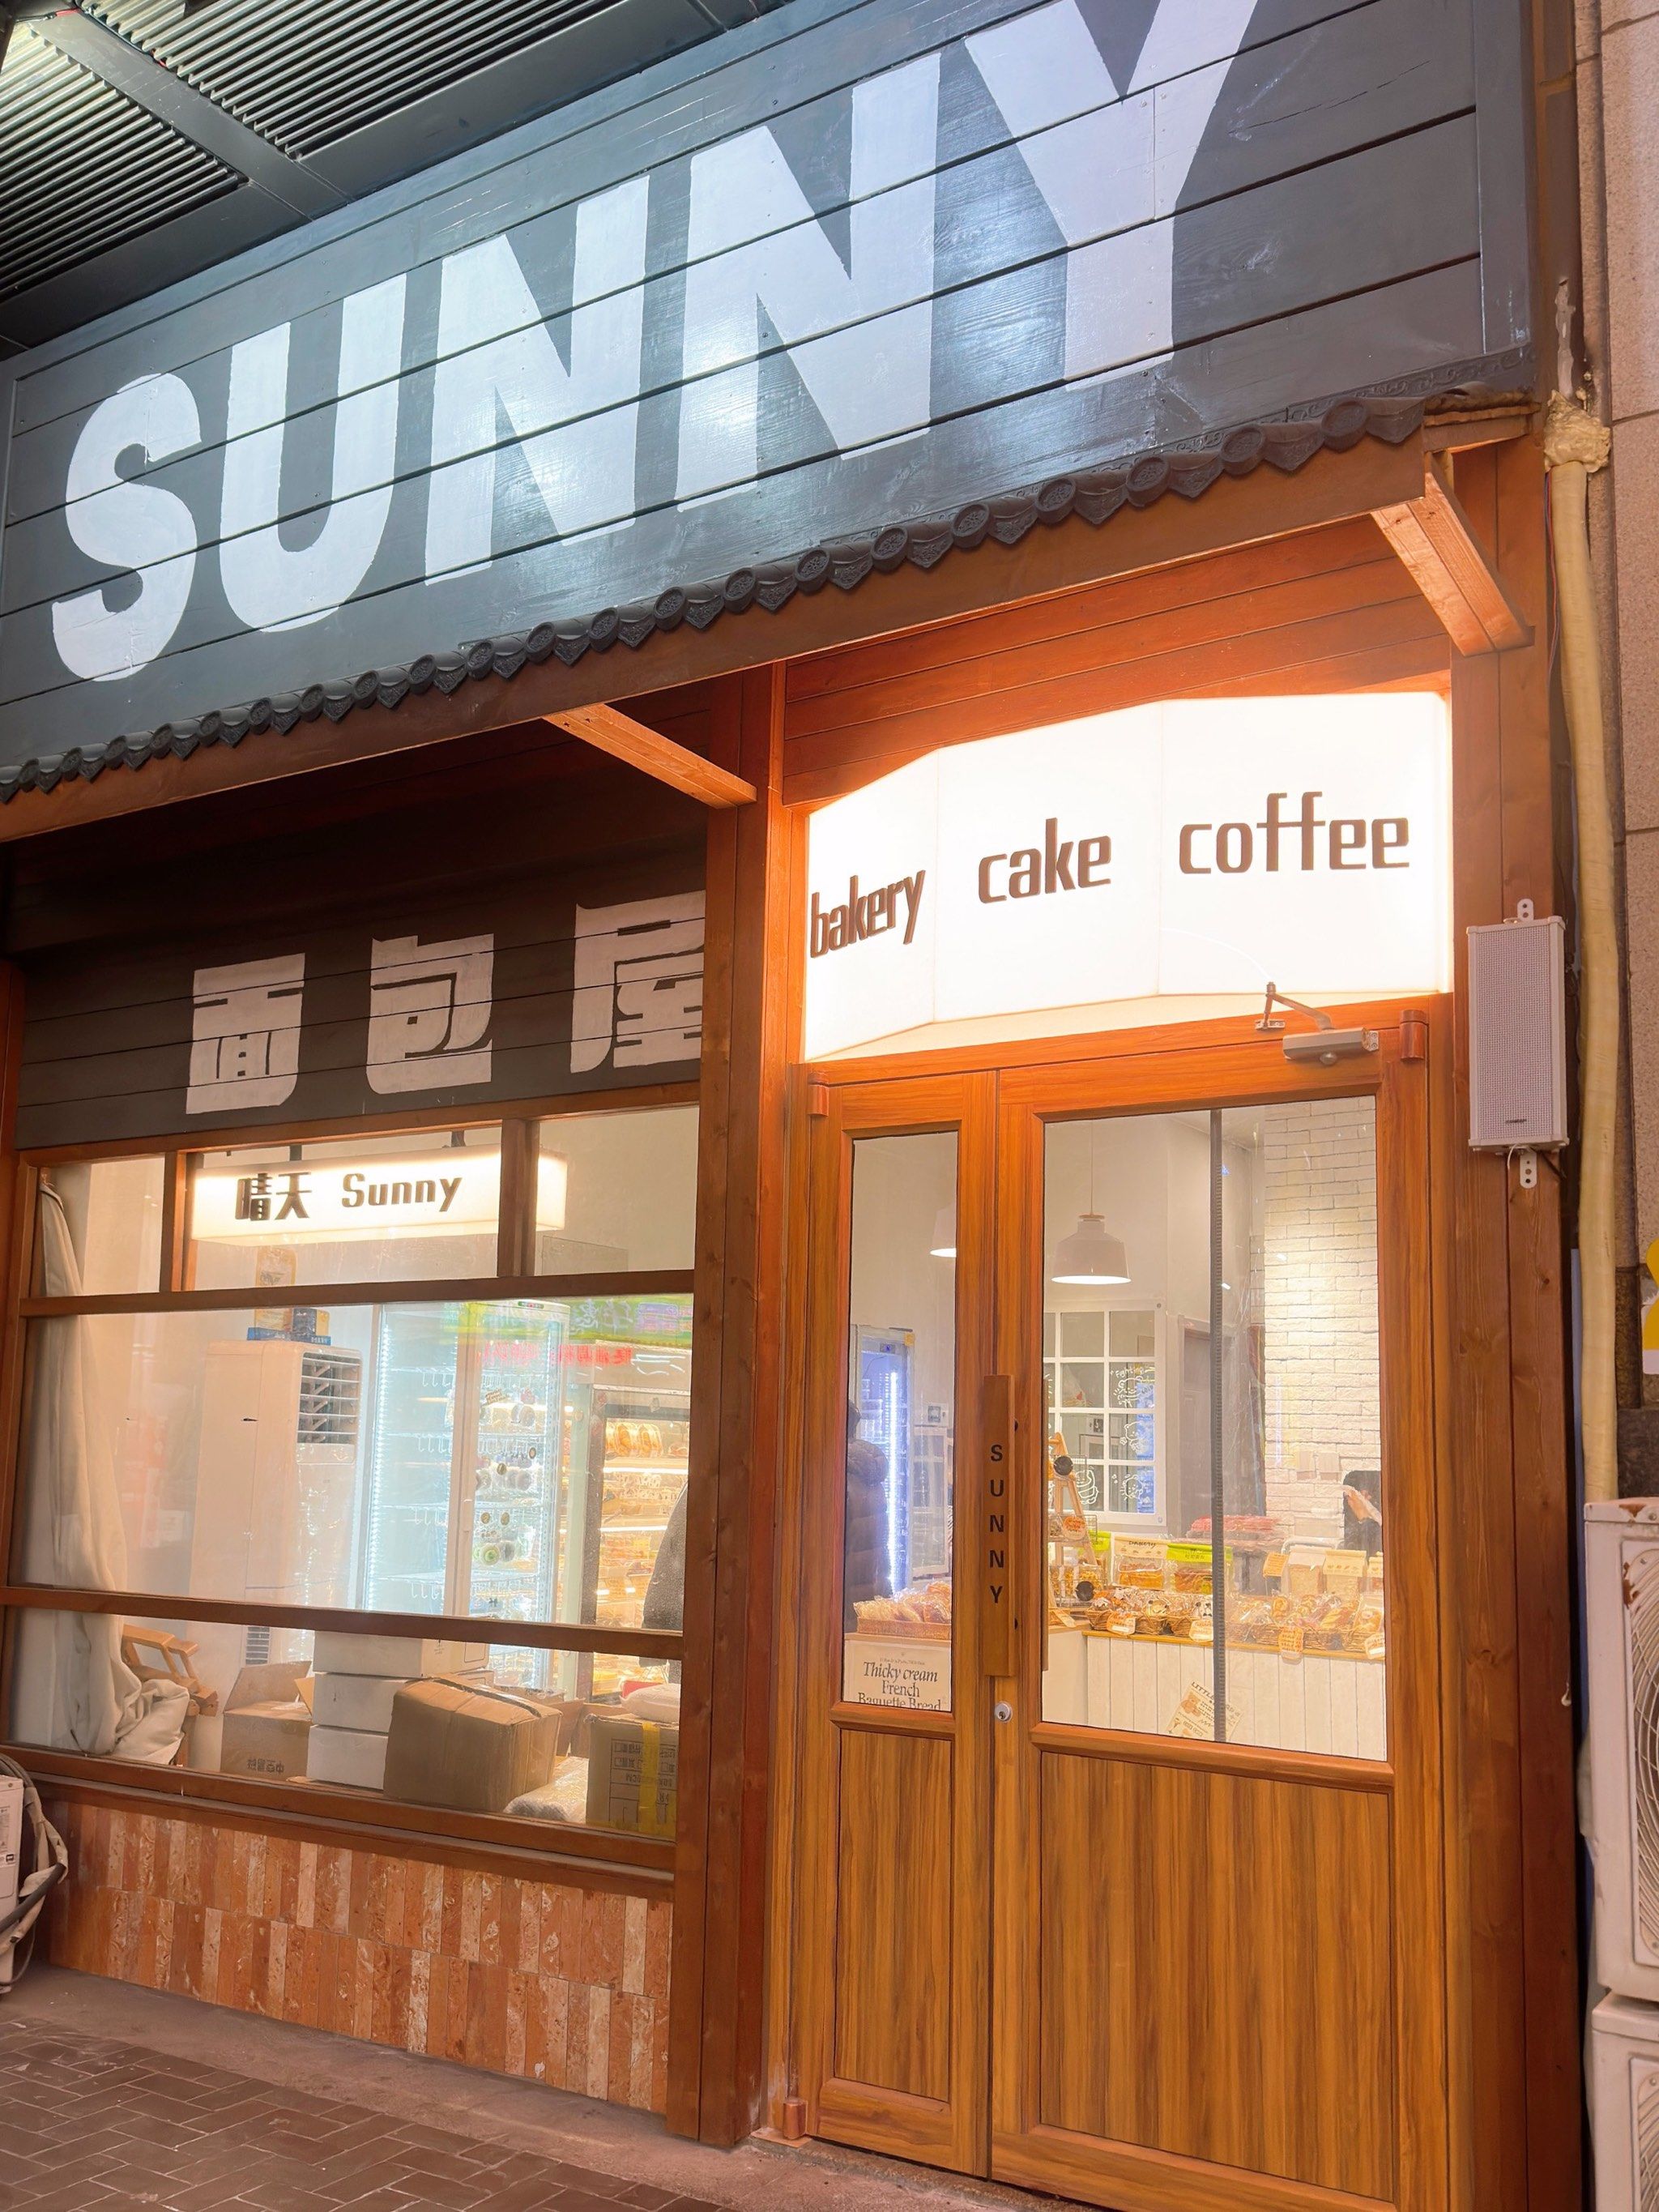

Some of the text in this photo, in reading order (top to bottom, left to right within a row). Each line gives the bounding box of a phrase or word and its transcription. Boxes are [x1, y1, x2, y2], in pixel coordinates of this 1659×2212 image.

[52, 0, 1258, 682] SUNNY
[810, 791, 1410, 959] bakery cake coffee
[186, 890, 706, 1115] 面包屋
[235, 1172, 463, 1222] 晴天 Sunny
[989, 1444, 1004, 1604] SUNNY
[864, 1661, 901, 1683] Thicky
[902, 1671, 938, 1683] cream
[882, 1680, 920, 1697] French
